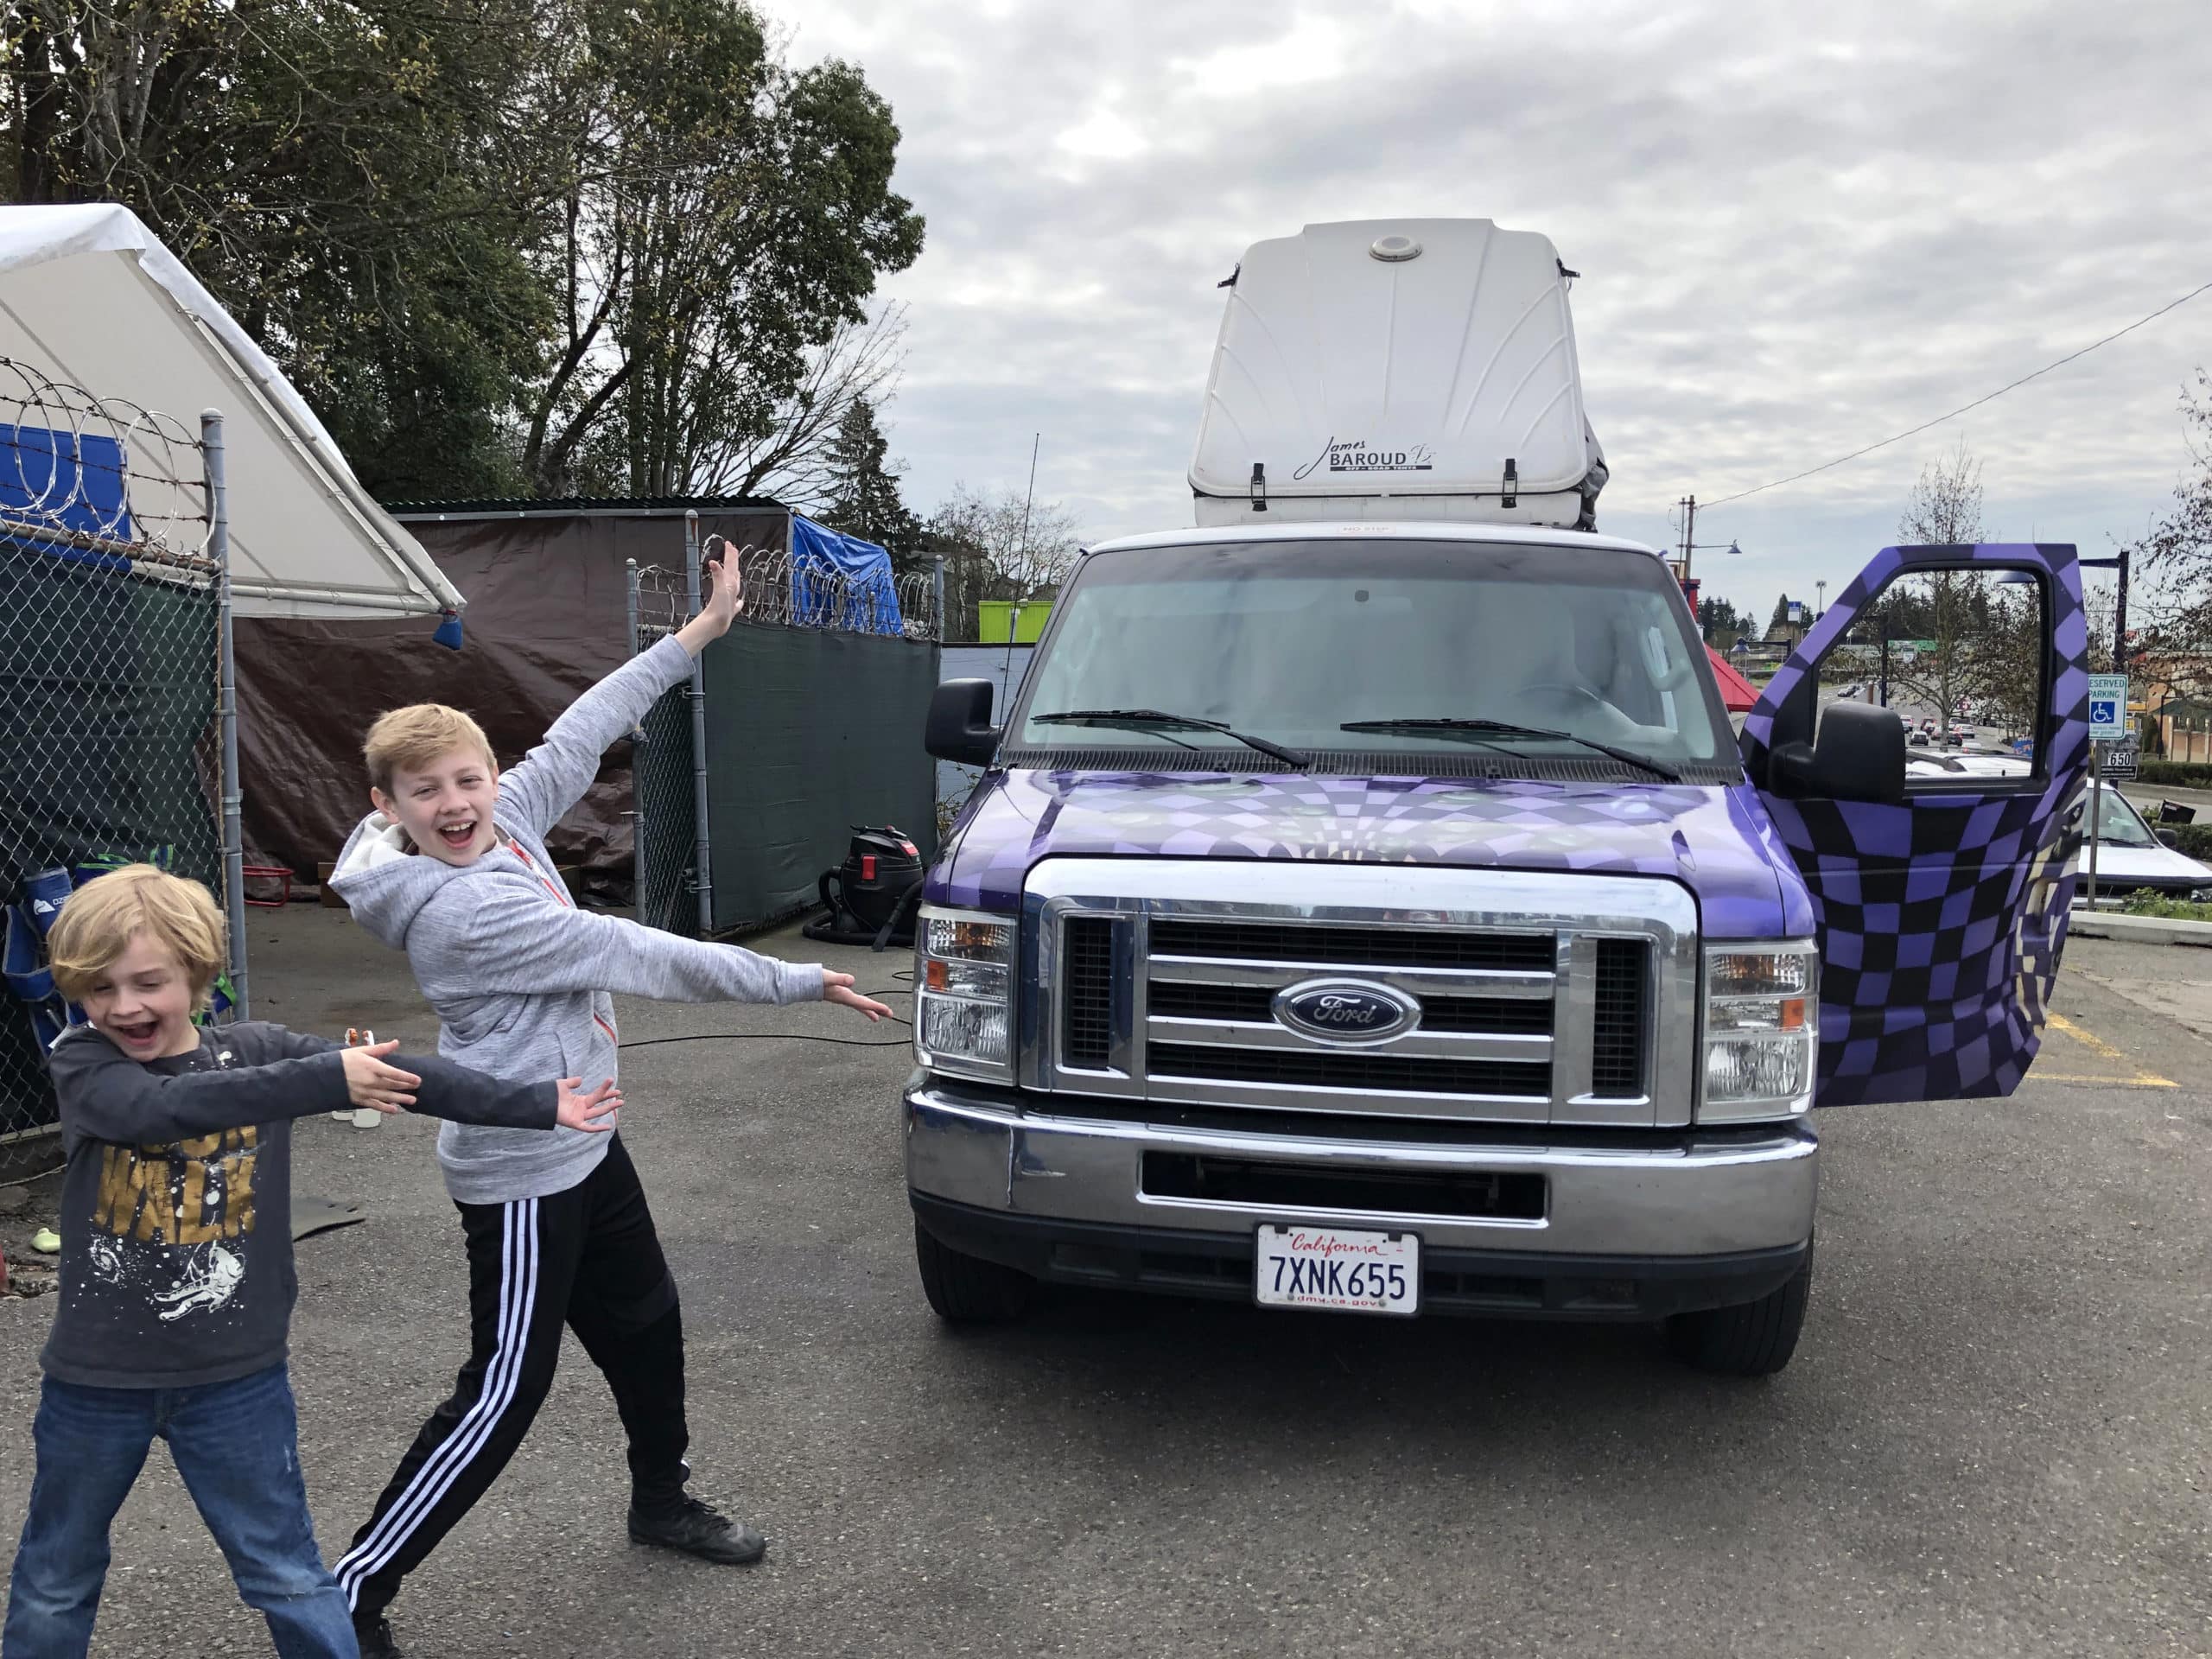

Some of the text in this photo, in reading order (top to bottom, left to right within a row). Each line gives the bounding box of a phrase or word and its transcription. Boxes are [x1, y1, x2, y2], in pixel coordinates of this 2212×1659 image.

[1294, 436, 1365, 480] James
[1330, 453, 1407, 466] BAROUD
[2088, 679, 2125, 688] ESERVED
[2110, 753, 2131, 766] 650
[1313, 995, 1378, 1024] Ford
[92, 1142, 257, 1245] WALK
[1291, 1233, 1389, 1257] California
[1268, 1255, 1406, 1300] 7XNK655
